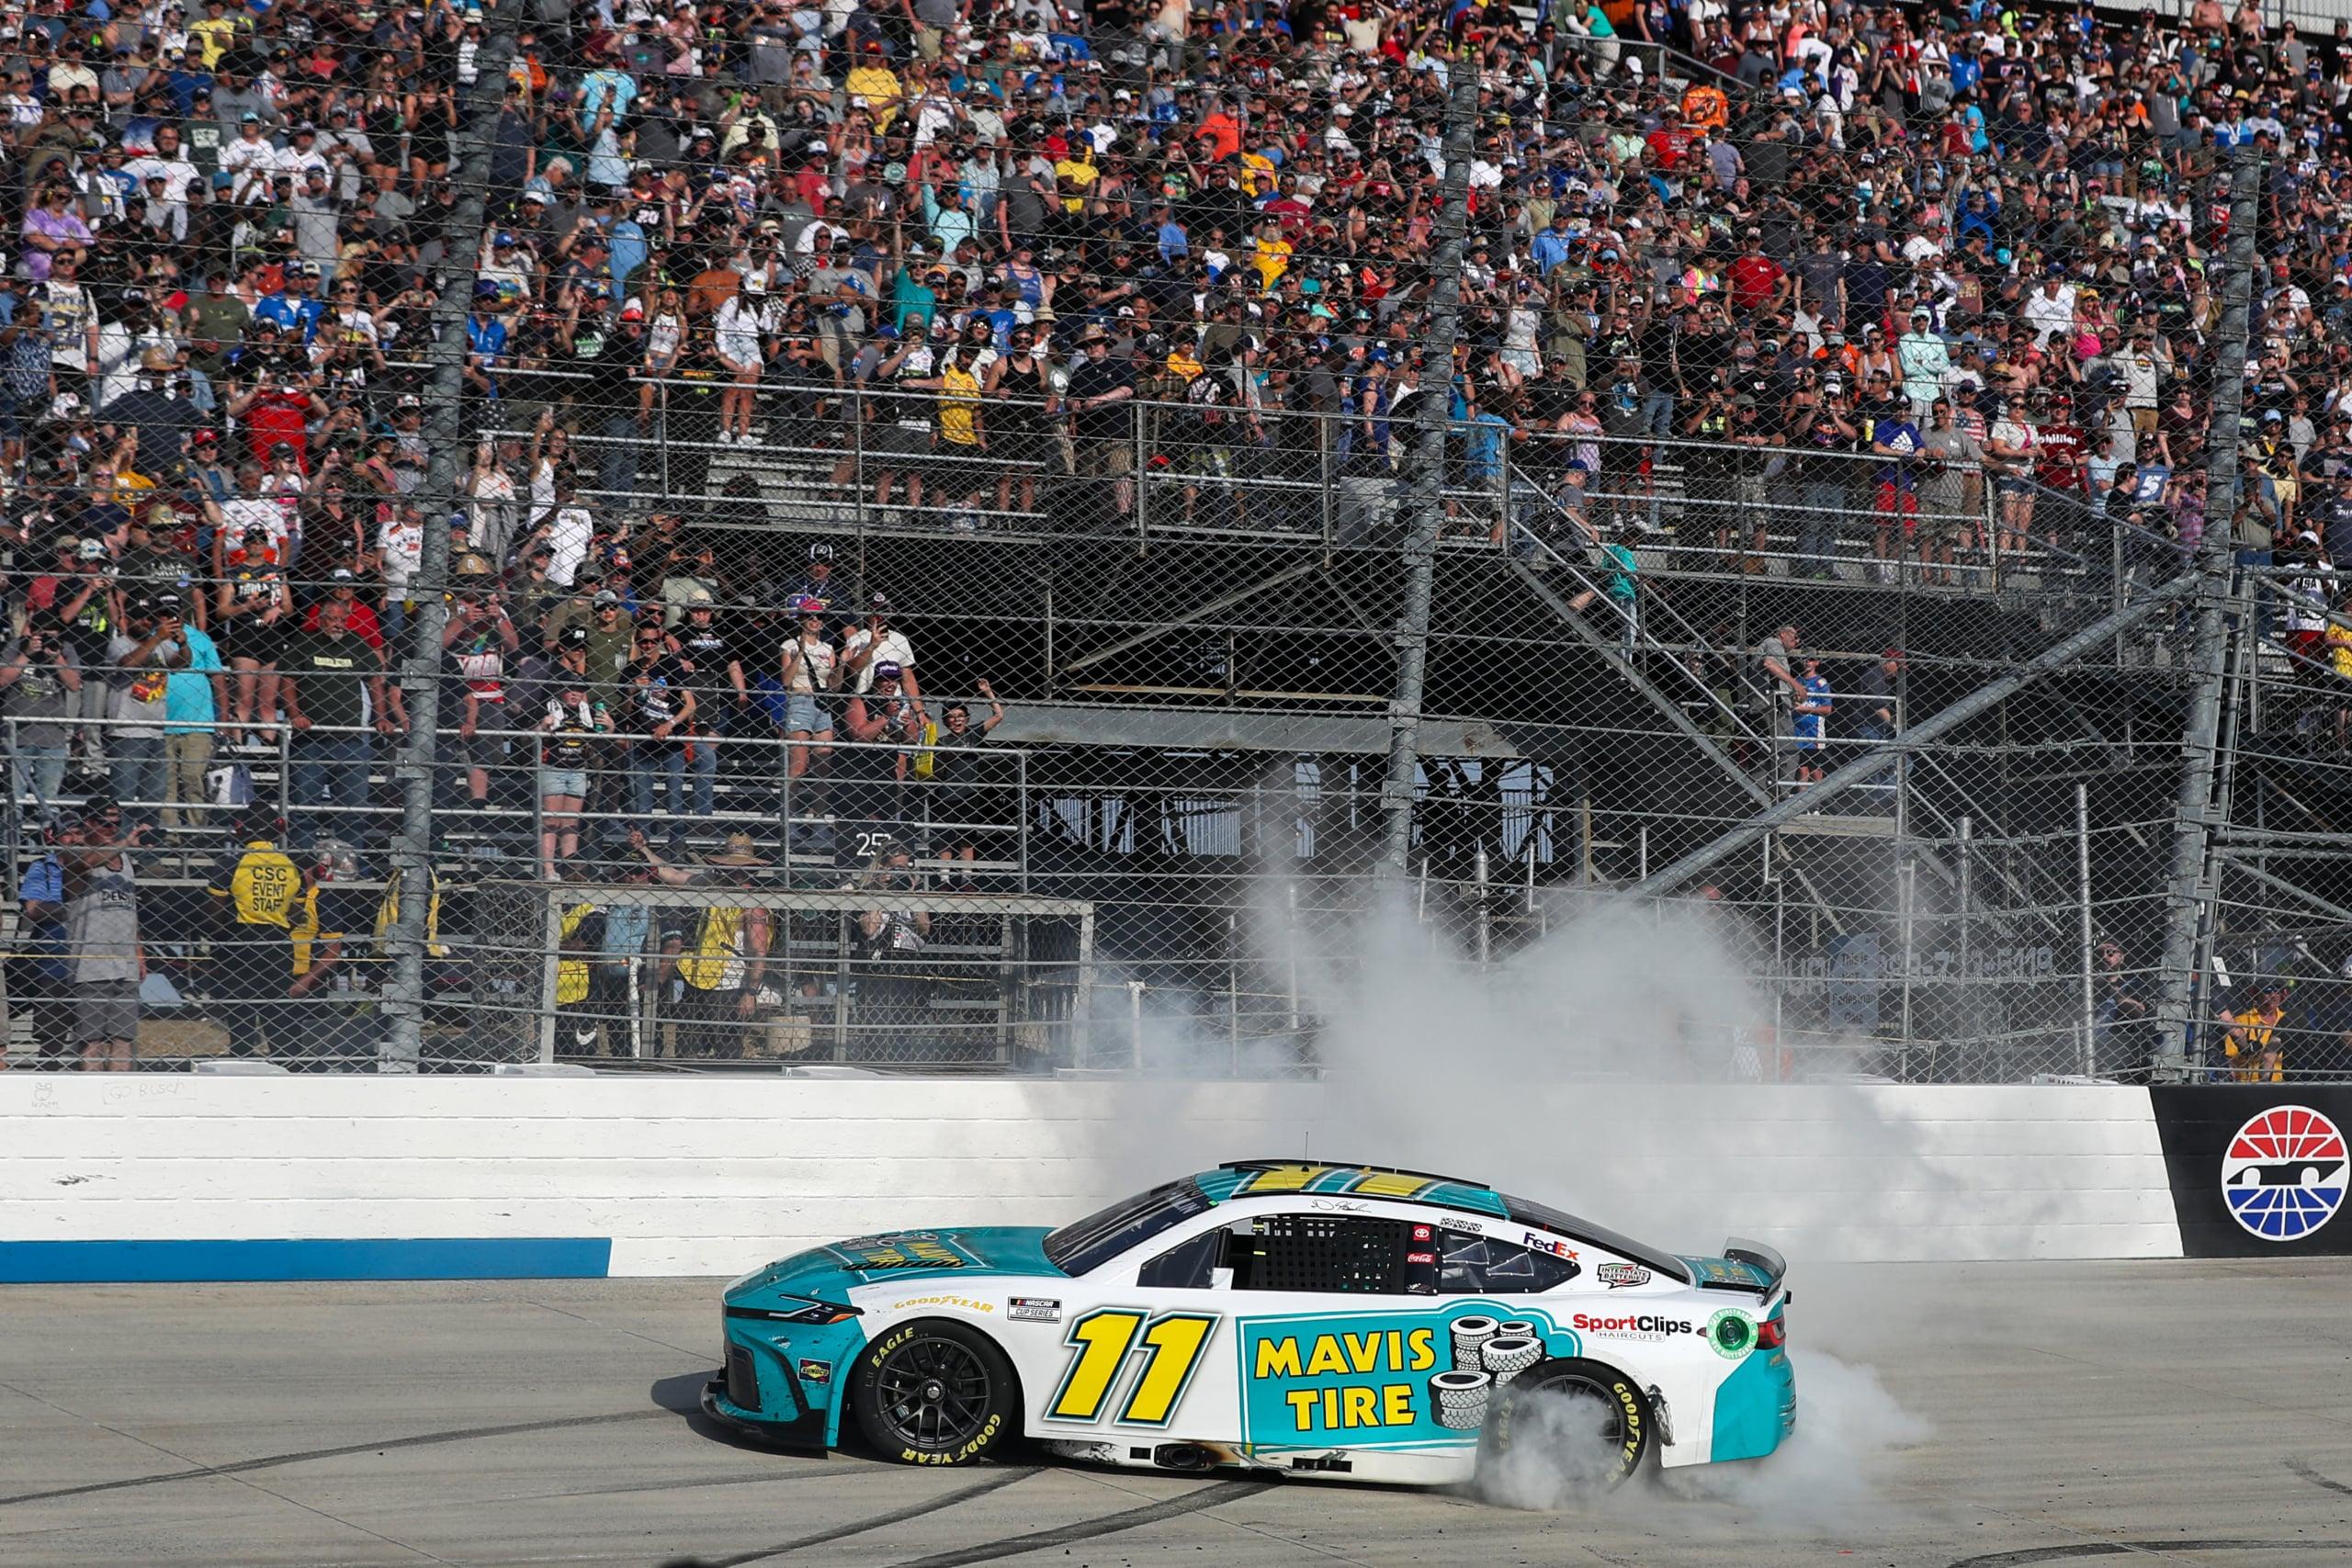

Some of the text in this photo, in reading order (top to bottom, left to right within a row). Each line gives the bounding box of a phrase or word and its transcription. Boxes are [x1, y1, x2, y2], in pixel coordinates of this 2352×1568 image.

[636, 209, 660, 225] 20
[1890, 442, 1915, 453] adida
[2138, 475, 2163, 497] 5
[253, 866, 288, 881] CSC
[252, 882, 287, 897] EVENT
[1523, 1232, 1580, 1260] FedEx
[1601, 1267, 1648, 1278] INTERSTATE
[1603, 1273, 1645, 1282] BATTERIES
[893, 1295, 994, 1313] GOODYEAR
[1030, 1309, 1054, 1317] SERIES
[1598, 1331, 1663, 1341] HAIRCUTS
[871, 1326, 914, 1368] EAGLE
[1254, 1327, 1436, 1380] MAVIS
[802, 1367, 829, 1376] SUNOCO
[1043, 1307, 1222, 1429] 11
[1286, 1383, 1418, 1432] TIRE
[901, 1414, 1001, 1464] GOODYEAR
